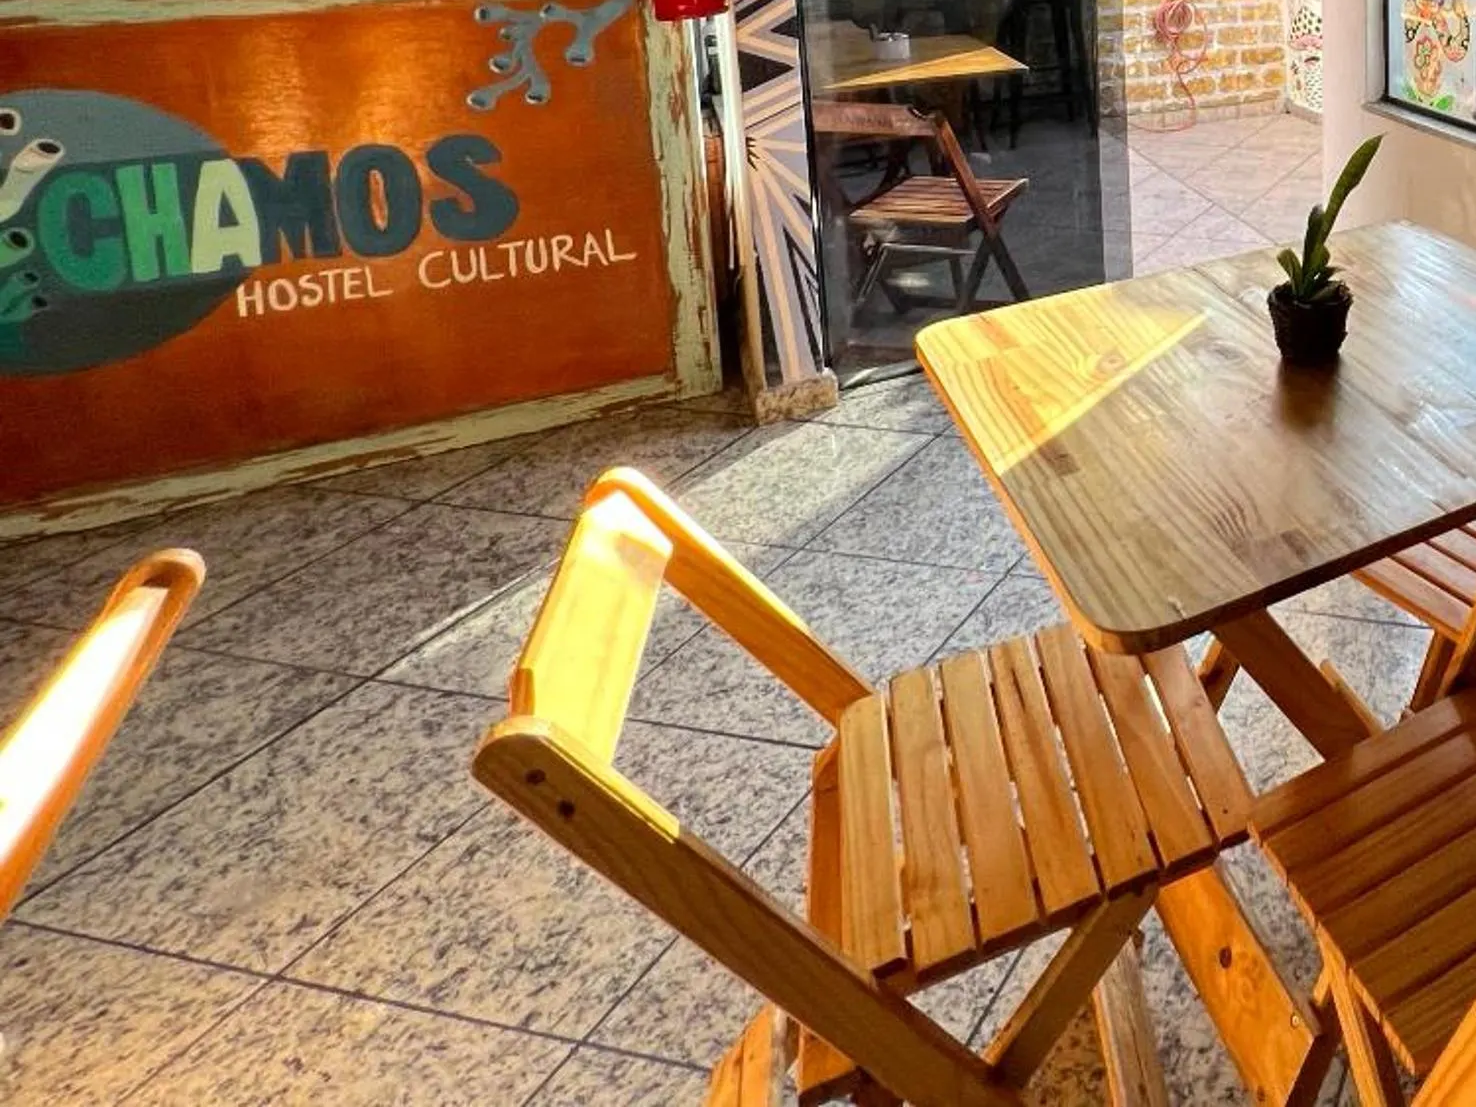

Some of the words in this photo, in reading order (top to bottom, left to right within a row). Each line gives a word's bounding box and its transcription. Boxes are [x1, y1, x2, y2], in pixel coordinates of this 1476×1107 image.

[36, 133, 521, 292] CHAMOS
[236, 267, 394, 318] HOSTEL
[417, 228, 637, 289] CULTURAL
